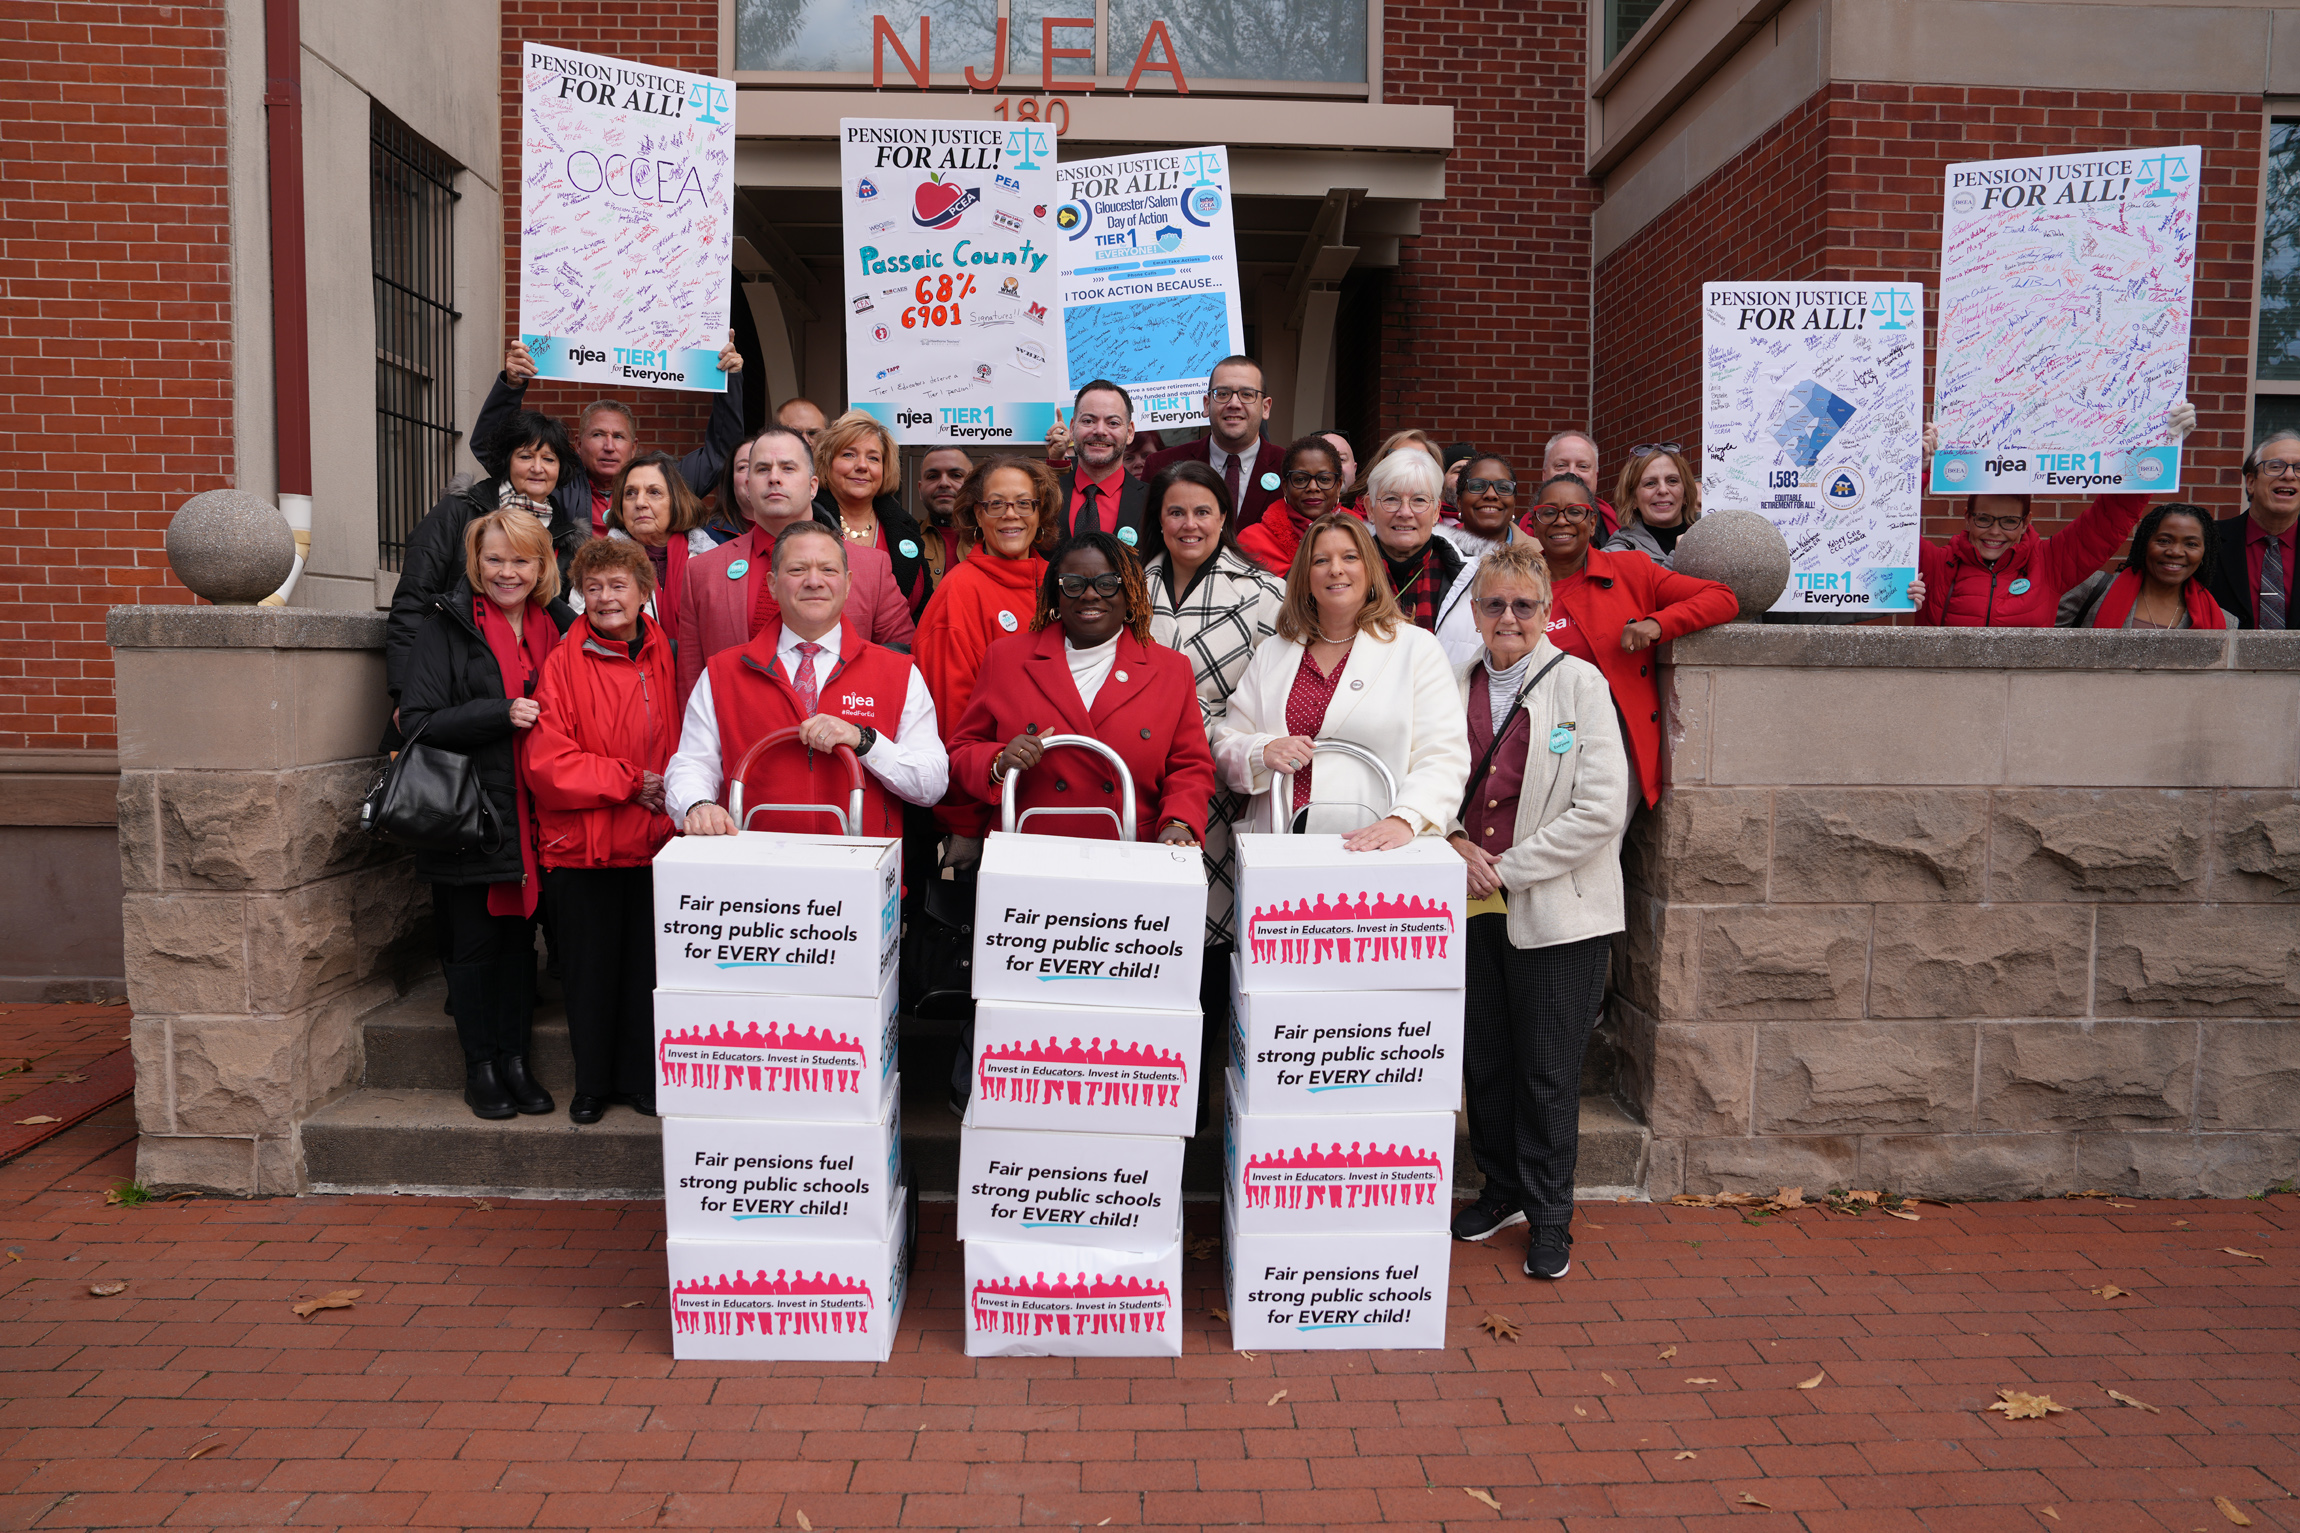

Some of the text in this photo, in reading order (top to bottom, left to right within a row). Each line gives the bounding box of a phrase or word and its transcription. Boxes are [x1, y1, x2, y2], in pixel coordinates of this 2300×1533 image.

[873, 14, 1189, 94] NJEA
[532, 54, 685, 94] PENSION JUSTICE
[558, 75, 685, 118] FOR ALL!
[993, 98, 1070, 136] 180
[848, 128, 1002, 146] PENSION JUSTICE
[875, 146, 1001, 169] FOR ALL!
[567, 150, 708, 209] OCCEA
[1057, 158, 1177, 182] ENSION JUSTICE
[1953, 161, 2132, 187] PENSION JUSTICE
[995, 174, 1020, 190] PEA
[1071, 170, 1178, 200] FOR ALL!
[1981, 185, 2046, 209] FOR
[2057, 178, 2131, 205] ALL!
[948, 192, 976, 217] PCEA
[1095, 196, 1177, 214] Gloucester/Salem
[1108, 213, 1167, 229] Day of Action
[859, 239, 1048, 275] Passaic County
[1098, 244, 1157, 260] EVERYONE!
[915, 273, 976, 305] 68%
[1065, 278, 1223, 301] I TOOK ACTION BECAUSE...
[1711, 291, 1867, 308] PENSION JUSTICE
[901, 303, 961, 328] 6901
[970, 309, 1020, 324] Signatures!!
[1738, 308, 1866, 330] FOR ALL!
[570, 347, 605, 365] njea
[611, 363, 684, 383] for Everyone
[886, 365, 900, 373] TAPP
[869, 387, 888, 396] Tier
[898, 381, 925, 390] Educators
[930, 376, 951, 384] deserve
[922, 390, 938, 398] Tier
[1168, 382, 1200, 390] retirement,
[897, 408, 932, 428] njea
[1141, 412, 1150, 420] for
[938, 423, 1012, 440] for Everyone
[1843, 469, 1859, 479] COUNTY
[1985, 455, 2026, 476] njea
[1769, 471, 1798, 489] 1,583
[2032, 472, 2122, 488] for Everyone
[1775, 494, 1801, 502] EQUITABLE
[1827, 536, 1846, 548] Kelsey
[1792, 589, 1869, 607] for Everyone
[842, 692, 874, 709] njea
[680, 895, 841, 916] Fair pensions fuel
[664, 921, 857, 941] strong public schools
[1258, 926, 1287, 934] Invest
[1290, 926, 1299, 934] in
[1301, 924, 1354, 934] Educators.
[1357, 924, 1386, 932] Invest
[1401, 922, 1447, 932] Students.
[685, 943, 835, 964] for EVERY child!
[988, 1064, 1180, 1081] Invest in Educators. Invest in Students.
[989, 1161, 1148, 1184] Fair pensions fuel
[972, 1183, 1160, 1207] strong public schools
[991, 1204, 1138, 1227] for EVERY child!
[1265, 1265, 1418, 1284] Fair pensions fuel
[681, 1299, 709, 1307] Invest
[712, 1299, 720, 1307] in
[723, 1299, 774, 1309] Educators.
[820, 1300, 866, 1308] Students.
[1249, 1287, 1431, 1306] strong public schools
[1268, 1309, 1410, 1323] for EVERY child!
